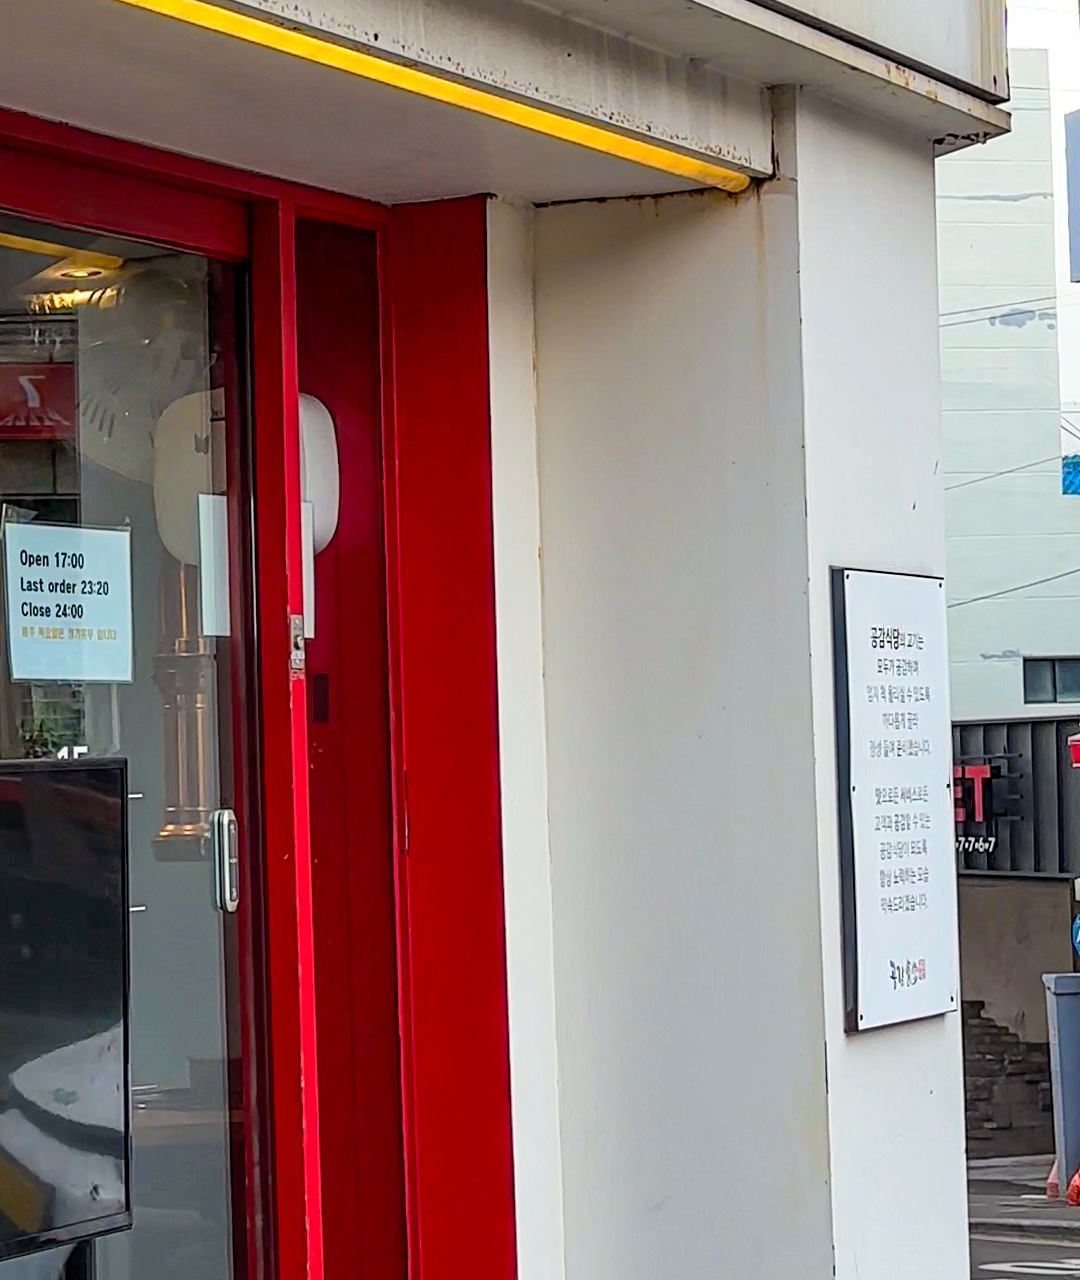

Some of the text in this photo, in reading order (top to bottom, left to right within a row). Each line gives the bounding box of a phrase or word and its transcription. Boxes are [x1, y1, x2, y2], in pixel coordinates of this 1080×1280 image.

[20, 549, 84, 569] Open 17:00
[20, 577, 109, 596] Last order 23:20
[21, 602, 84, 619] Close 24:00
[870, 626, 905, 651] 공감식당의
